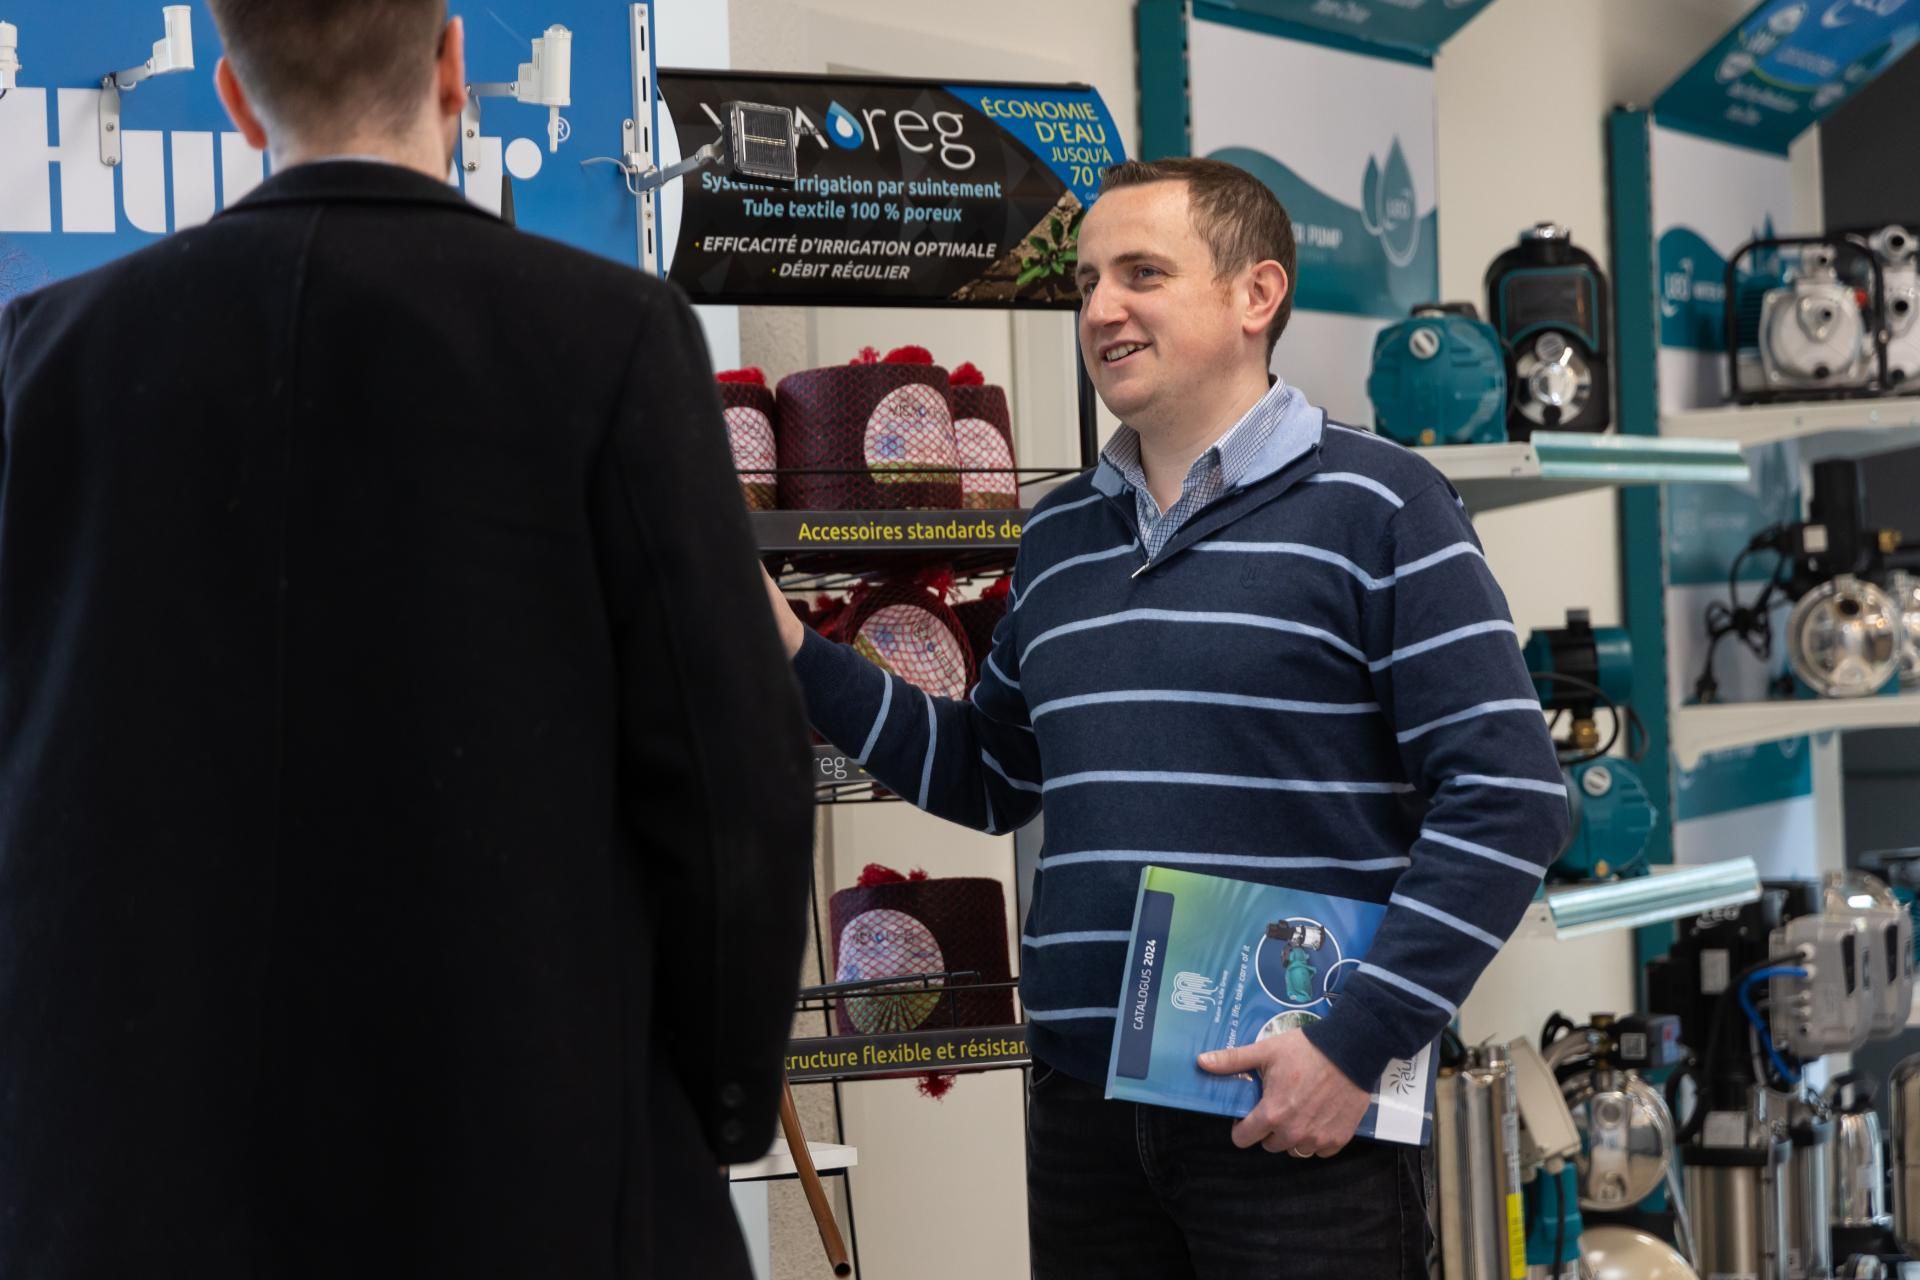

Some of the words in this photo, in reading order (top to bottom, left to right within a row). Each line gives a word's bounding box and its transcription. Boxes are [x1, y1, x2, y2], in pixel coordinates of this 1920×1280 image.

[981, 96, 1099, 121] ÉCONOMIE
[1035, 121, 1106, 144] D'EAU
[781, 174, 873, 196] irrigation
[877, 180, 904, 198] par
[908, 178, 1002, 198] suintement
[1070, 166, 1094, 186] 70
[743, 198, 784, 217] Tube
[789, 200, 846, 218] textile
[851, 202, 880, 219] 100
[884, 203, 900, 220] %
[903, 206, 962, 224] poreux
[703, 234, 798, 253] EFFICACITÉ
[800, 237, 910, 256] D'IRRIGATION
[914, 241, 997, 258] OPTIMALE
[779, 259, 829, 277] DÉBIT
[831, 260, 910, 279] RÉGULIER
[799, 521, 903, 541] Accessoires
[907, 519, 995, 540] standards
[1000, 519, 1021, 538] de
[1133, 968, 1152, 1031] CATALOGUS
[1143, 939, 1157, 967] 2024
[784, 1050, 858, 1071] tructure
[862, 1041, 932, 1065] flexible
[936, 1045, 955, 1061] et
[960, 1038, 1029, 1059] résistan
